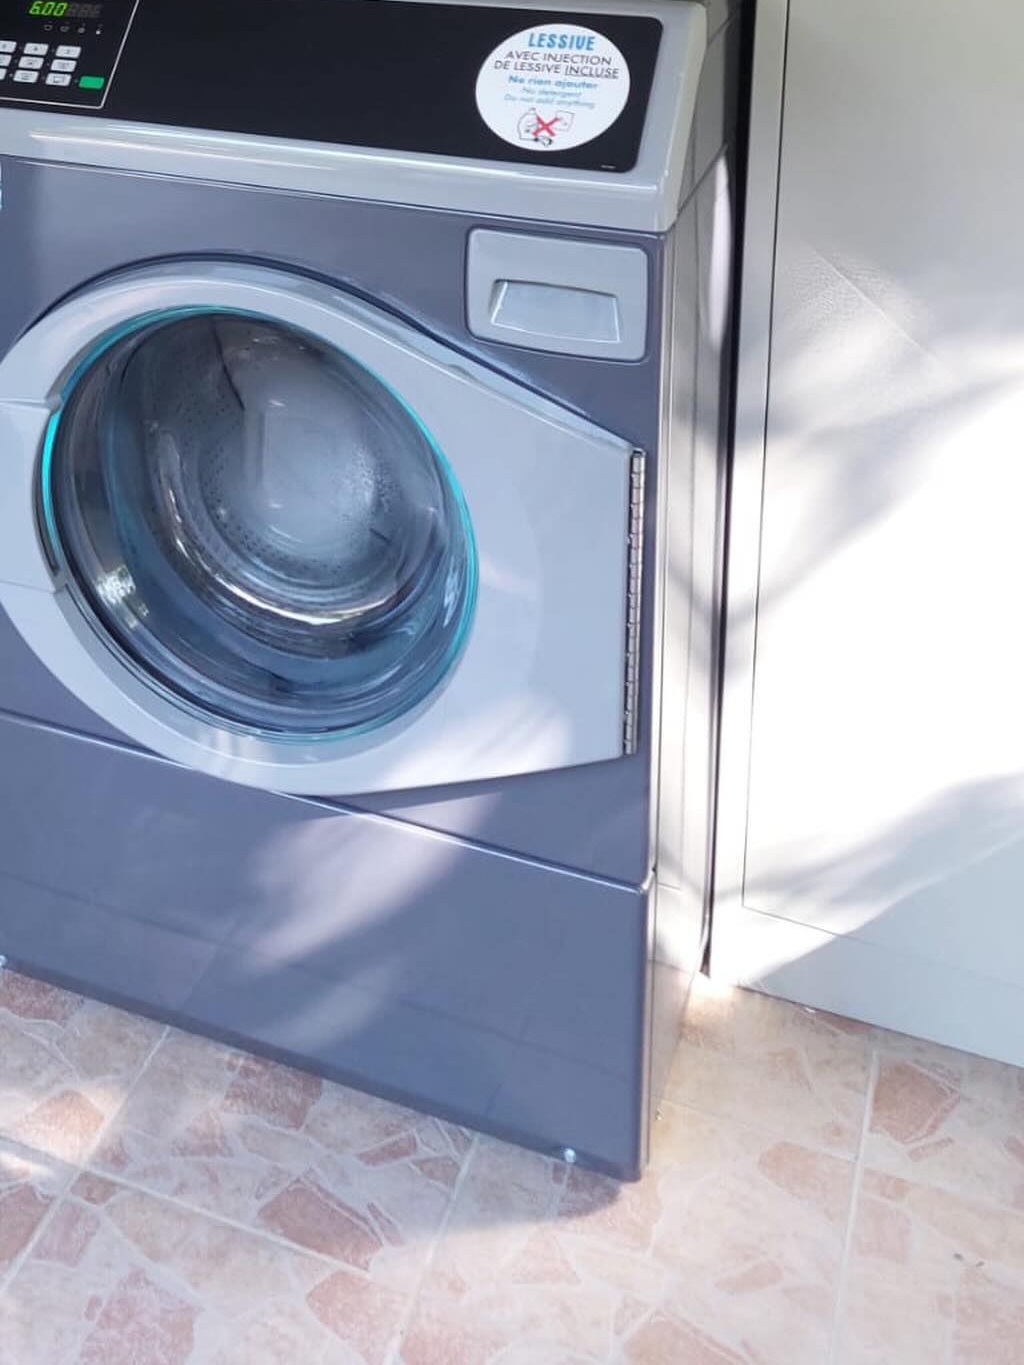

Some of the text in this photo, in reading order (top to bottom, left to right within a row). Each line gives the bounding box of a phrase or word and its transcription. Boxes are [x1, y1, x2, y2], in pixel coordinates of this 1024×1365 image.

[528, 33, 595, 51] LESSIVE
[504, 50, 612, 66] AVEC INJECTION
[494, 60, 620, 80] DE LESSIVE INCLUSE
[508, 75, 598, 91] Ne rien ajouter
